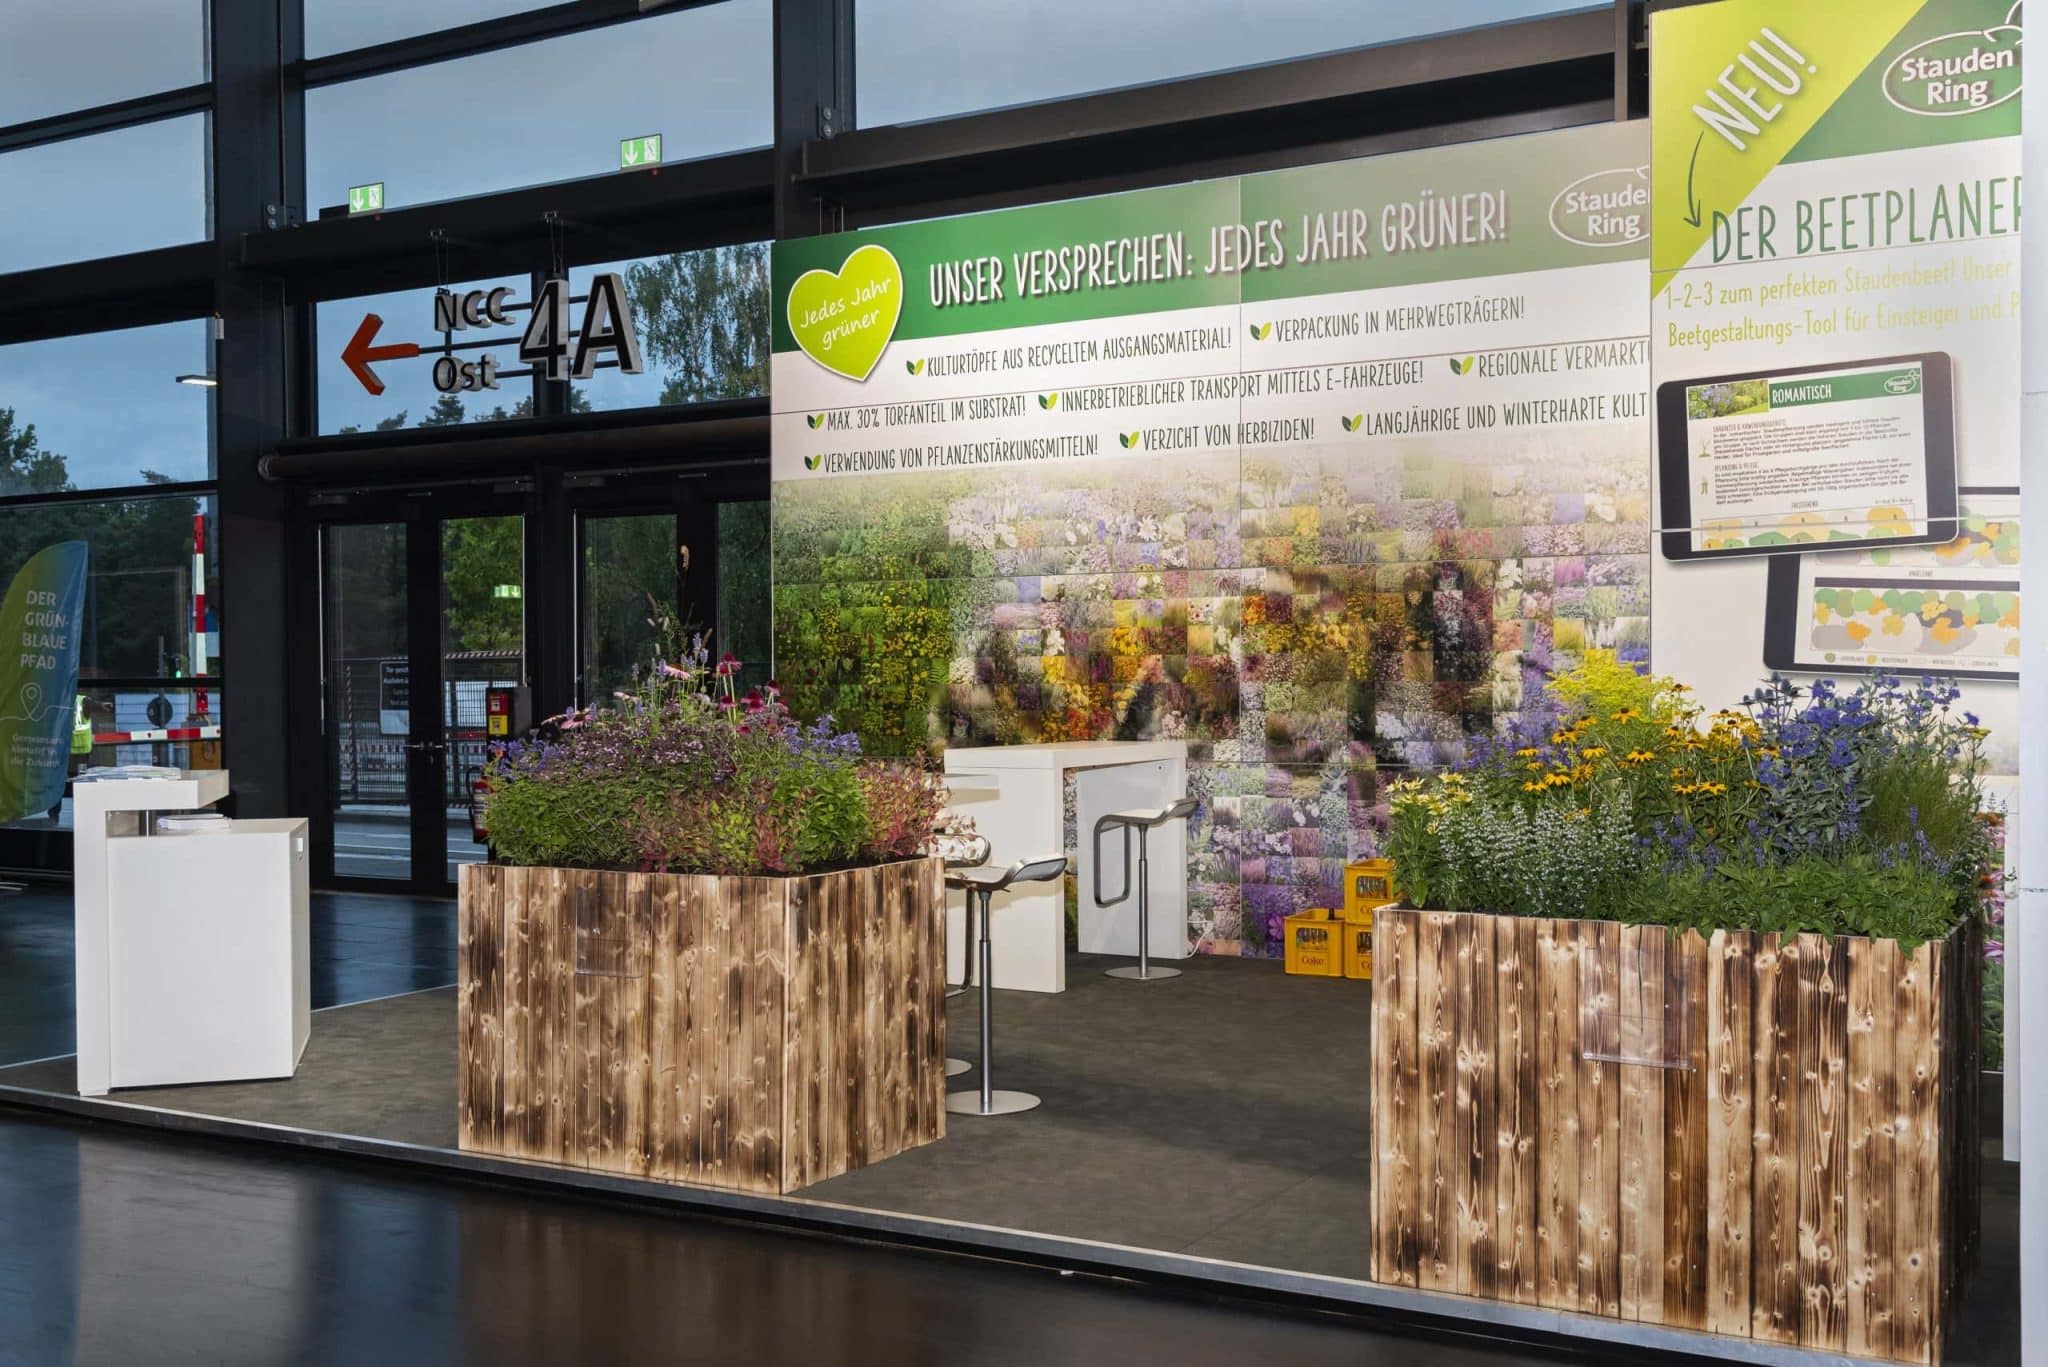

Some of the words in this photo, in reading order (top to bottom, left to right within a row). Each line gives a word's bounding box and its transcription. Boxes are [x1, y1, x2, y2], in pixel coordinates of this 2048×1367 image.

[1901, 48, 2013, 83] Stauden
[1692, 27, 1817, 151] NEU!
[1927, 79, 1988, 107] Ring
[1566, 184, 1650, 214] Staude
[1588, 212, 1640, 239] Ring
[1712, 205, 1777, 263] DER
[930, 256, 1004, 307] UNSER
[1014, 231, 1193, 297] VERSPRECHEN:
[1204, 219, 1284, 274] JEDES
[1296, 208, 1368, 263] JAHR
[1381, 189, 1506, 253] GRÜNER!
[800, 297, 846, 329] Jedes
[851, 276, 892, 308] Jahr
[1664, 281, 1713, 310] 1-2-3
[1720, 286, 1753, 305] zum
[1760, 272, 1836, 307] perfekten
[1845, 256, 1956, 292] Staudenbeet!
[1963, 256, 2012, 283] Unser
[434, 286, 516, 332] NCC
[519, 272, 644, 381] 4A
[822, 308, 880, 351] grüner
[1275, 312, 1359, 343] VERPACKUNG
[1365, 310, 1380, 334] IN
[1386, 295, 1525, 331] MEHRWEGTRÄGERN!
[1668, 308, 1836, 351] Beetgestaltungs-Tool
[1845, 304, 1870, 333] für
[1878, 302, 1960, 331] Einsteiger
[1969, 289, 2001, 321] und
[927, 348, 997, 377] KULTURTÖPFE
[1002, 347, 1023, 369] AUS
[1028, 340, 1098, 368] RECYCELTEM
[1103, 327, 1232, 360] AUSGANGSMATERIAL!
[1478, 348, 1558, 378] REGIONALE
[1565, 340, 1650, 371] VERMARKT
[433, 353, 499, 394] Ost
[1061, 382, 1185, 413] INNERBETRIEBLICHER
[1191, 374, 1262, 400] TRANSPORT
[1268, 369, 1320, 395] MITTELS
[1326, 360, 1424, 391] E-FAHRZEUGE!
[1772, 384, 1832, 404] ROMANTISCH
[827, 411, 853, 432] MAX.
[857, 408, 880, 429] 30%
[884, 402, 947, 427] TORFANTEIL
[951, 401, 965, 422] IM
[969, 395, 1027, 421] SUBSTRAT!
[1366, 405, 1460, 436] LANGJÄHRIGE
[1467, 405, 1496, 429] UND
[1503, 395, 1605, 426] WINTERHARTE
[1613, 392, 1648, 419] KULT
[823, 449, 895, 473] VERWENDUNG
[899, 447, 923, 468] VON
[927, 434, 1098, 467] PFLANZENSTÄRKUNGSMITTELN!
[1143, 426, 1200, 451] VERZICHT
[1204, 424, 1231, 446] VON
[1237, 418, 1315, 445] HERBIZIDEN!
[26, 590, 57, 606] DER
[25, 610, 70, 628] GRÜN-
[22, 632, 67, 650] BLAUE
[20, 654, 57, 670] PFAD
